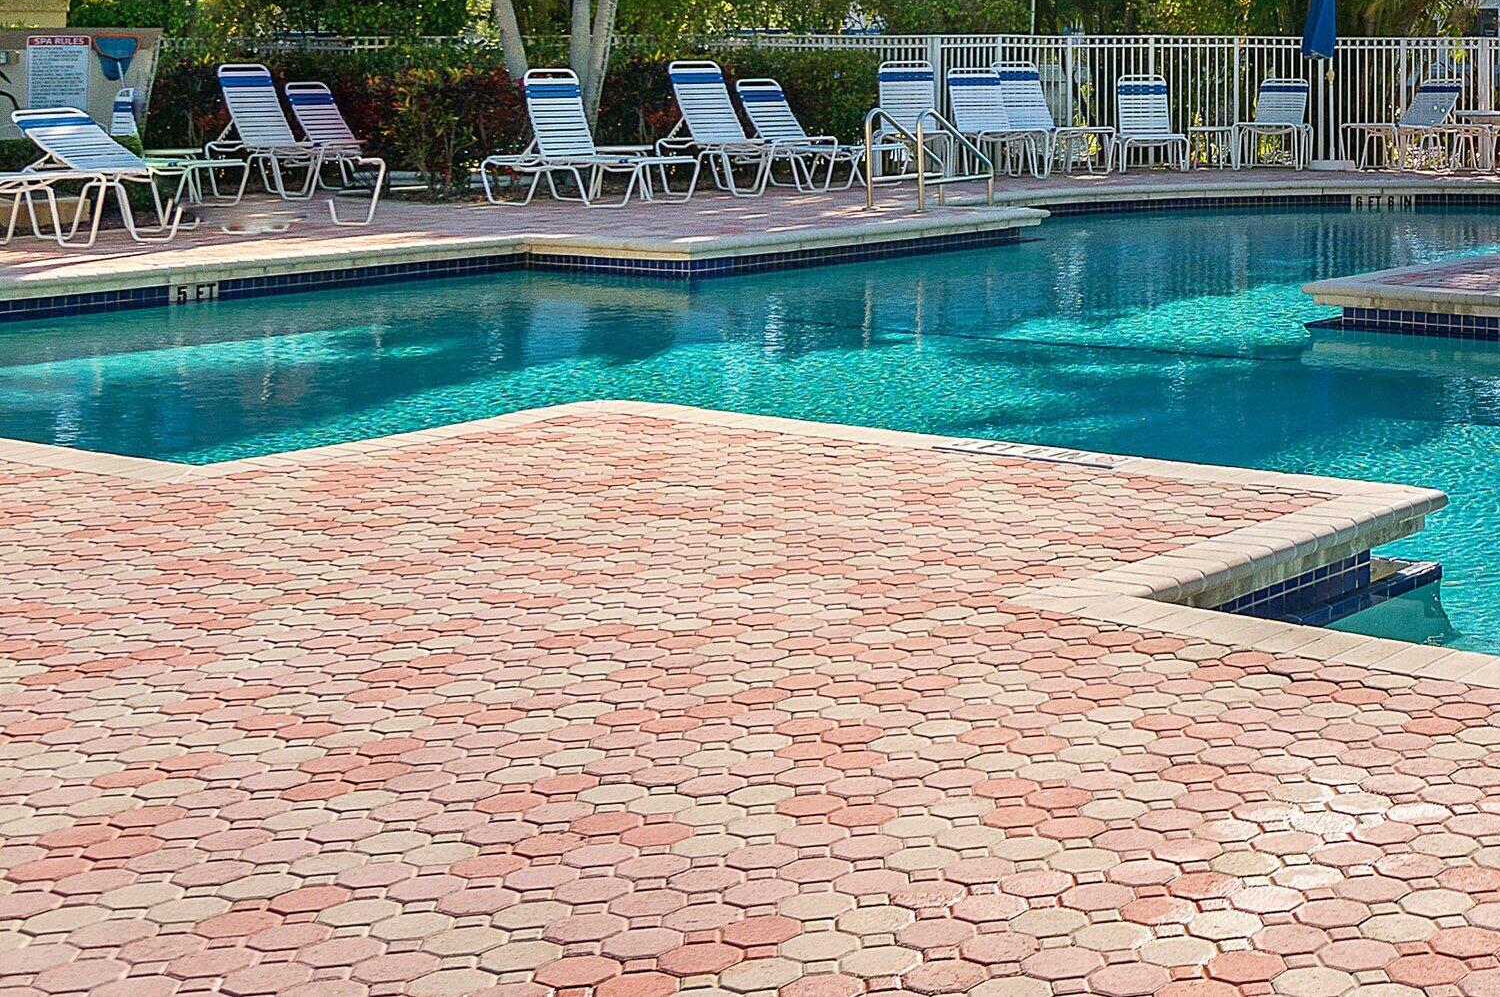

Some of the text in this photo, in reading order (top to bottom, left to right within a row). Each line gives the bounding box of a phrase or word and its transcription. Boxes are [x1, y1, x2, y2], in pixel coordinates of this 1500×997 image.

[1368, 196, 1382, 206] FT
[1400, 196, 1412, 206] IN
[178, 283, 216, 302] 5 FT
